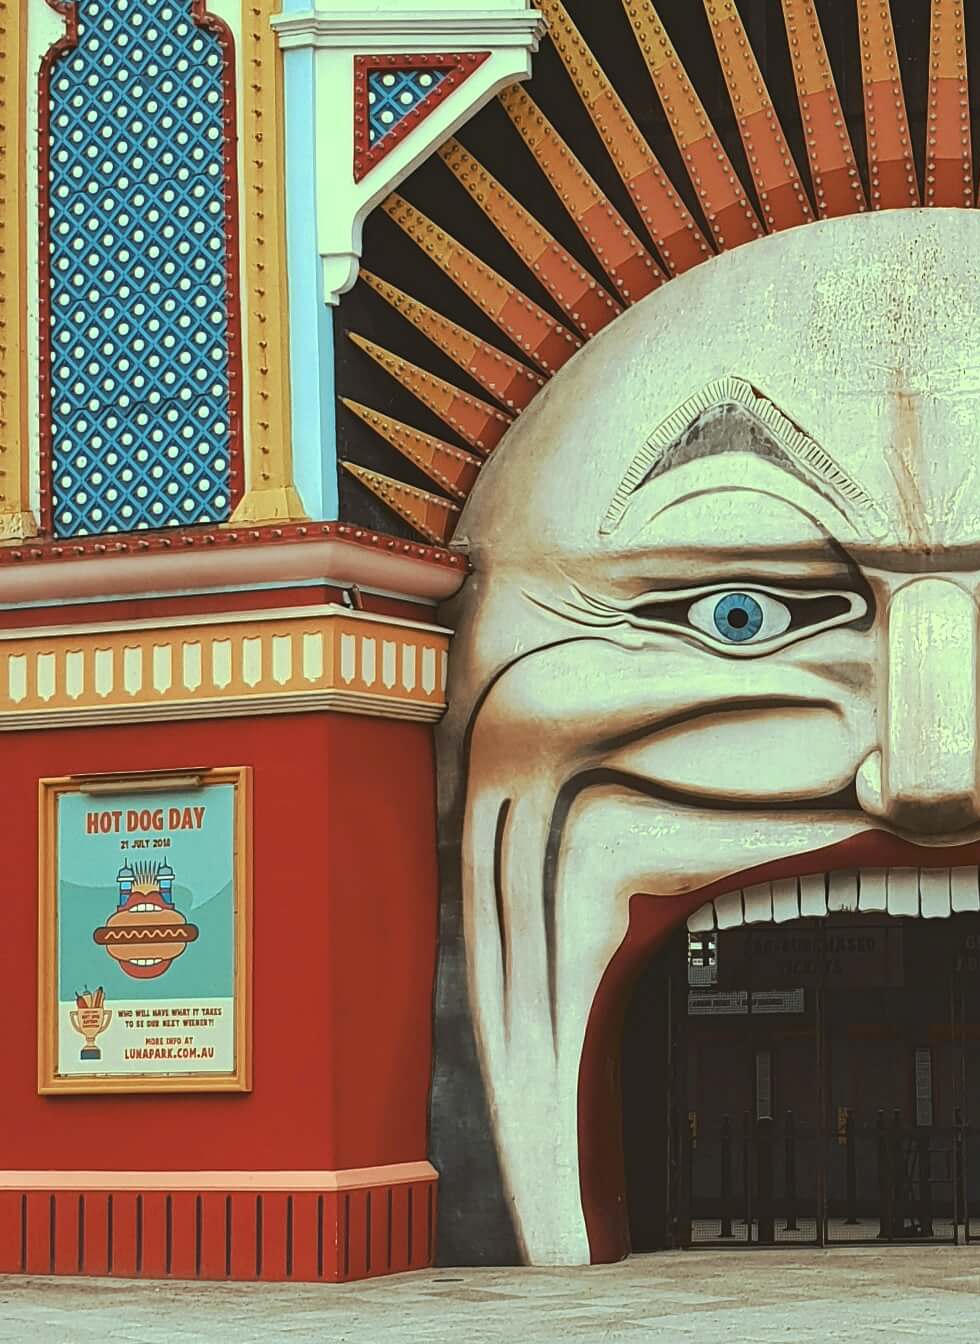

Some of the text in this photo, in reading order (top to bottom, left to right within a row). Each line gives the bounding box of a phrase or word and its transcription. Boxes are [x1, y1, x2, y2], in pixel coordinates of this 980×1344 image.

[87, 807, 205, 834] HOT DOG DAY
[120, 840, 129, 849] 21
[131, 839, 150, 849] JULY
[201, 1008, 222, 1016] TAKES
[166, 1037, 182, 1045] INFO
[124, 1047, 214, 1059] LUNAPARK.COM.AU
